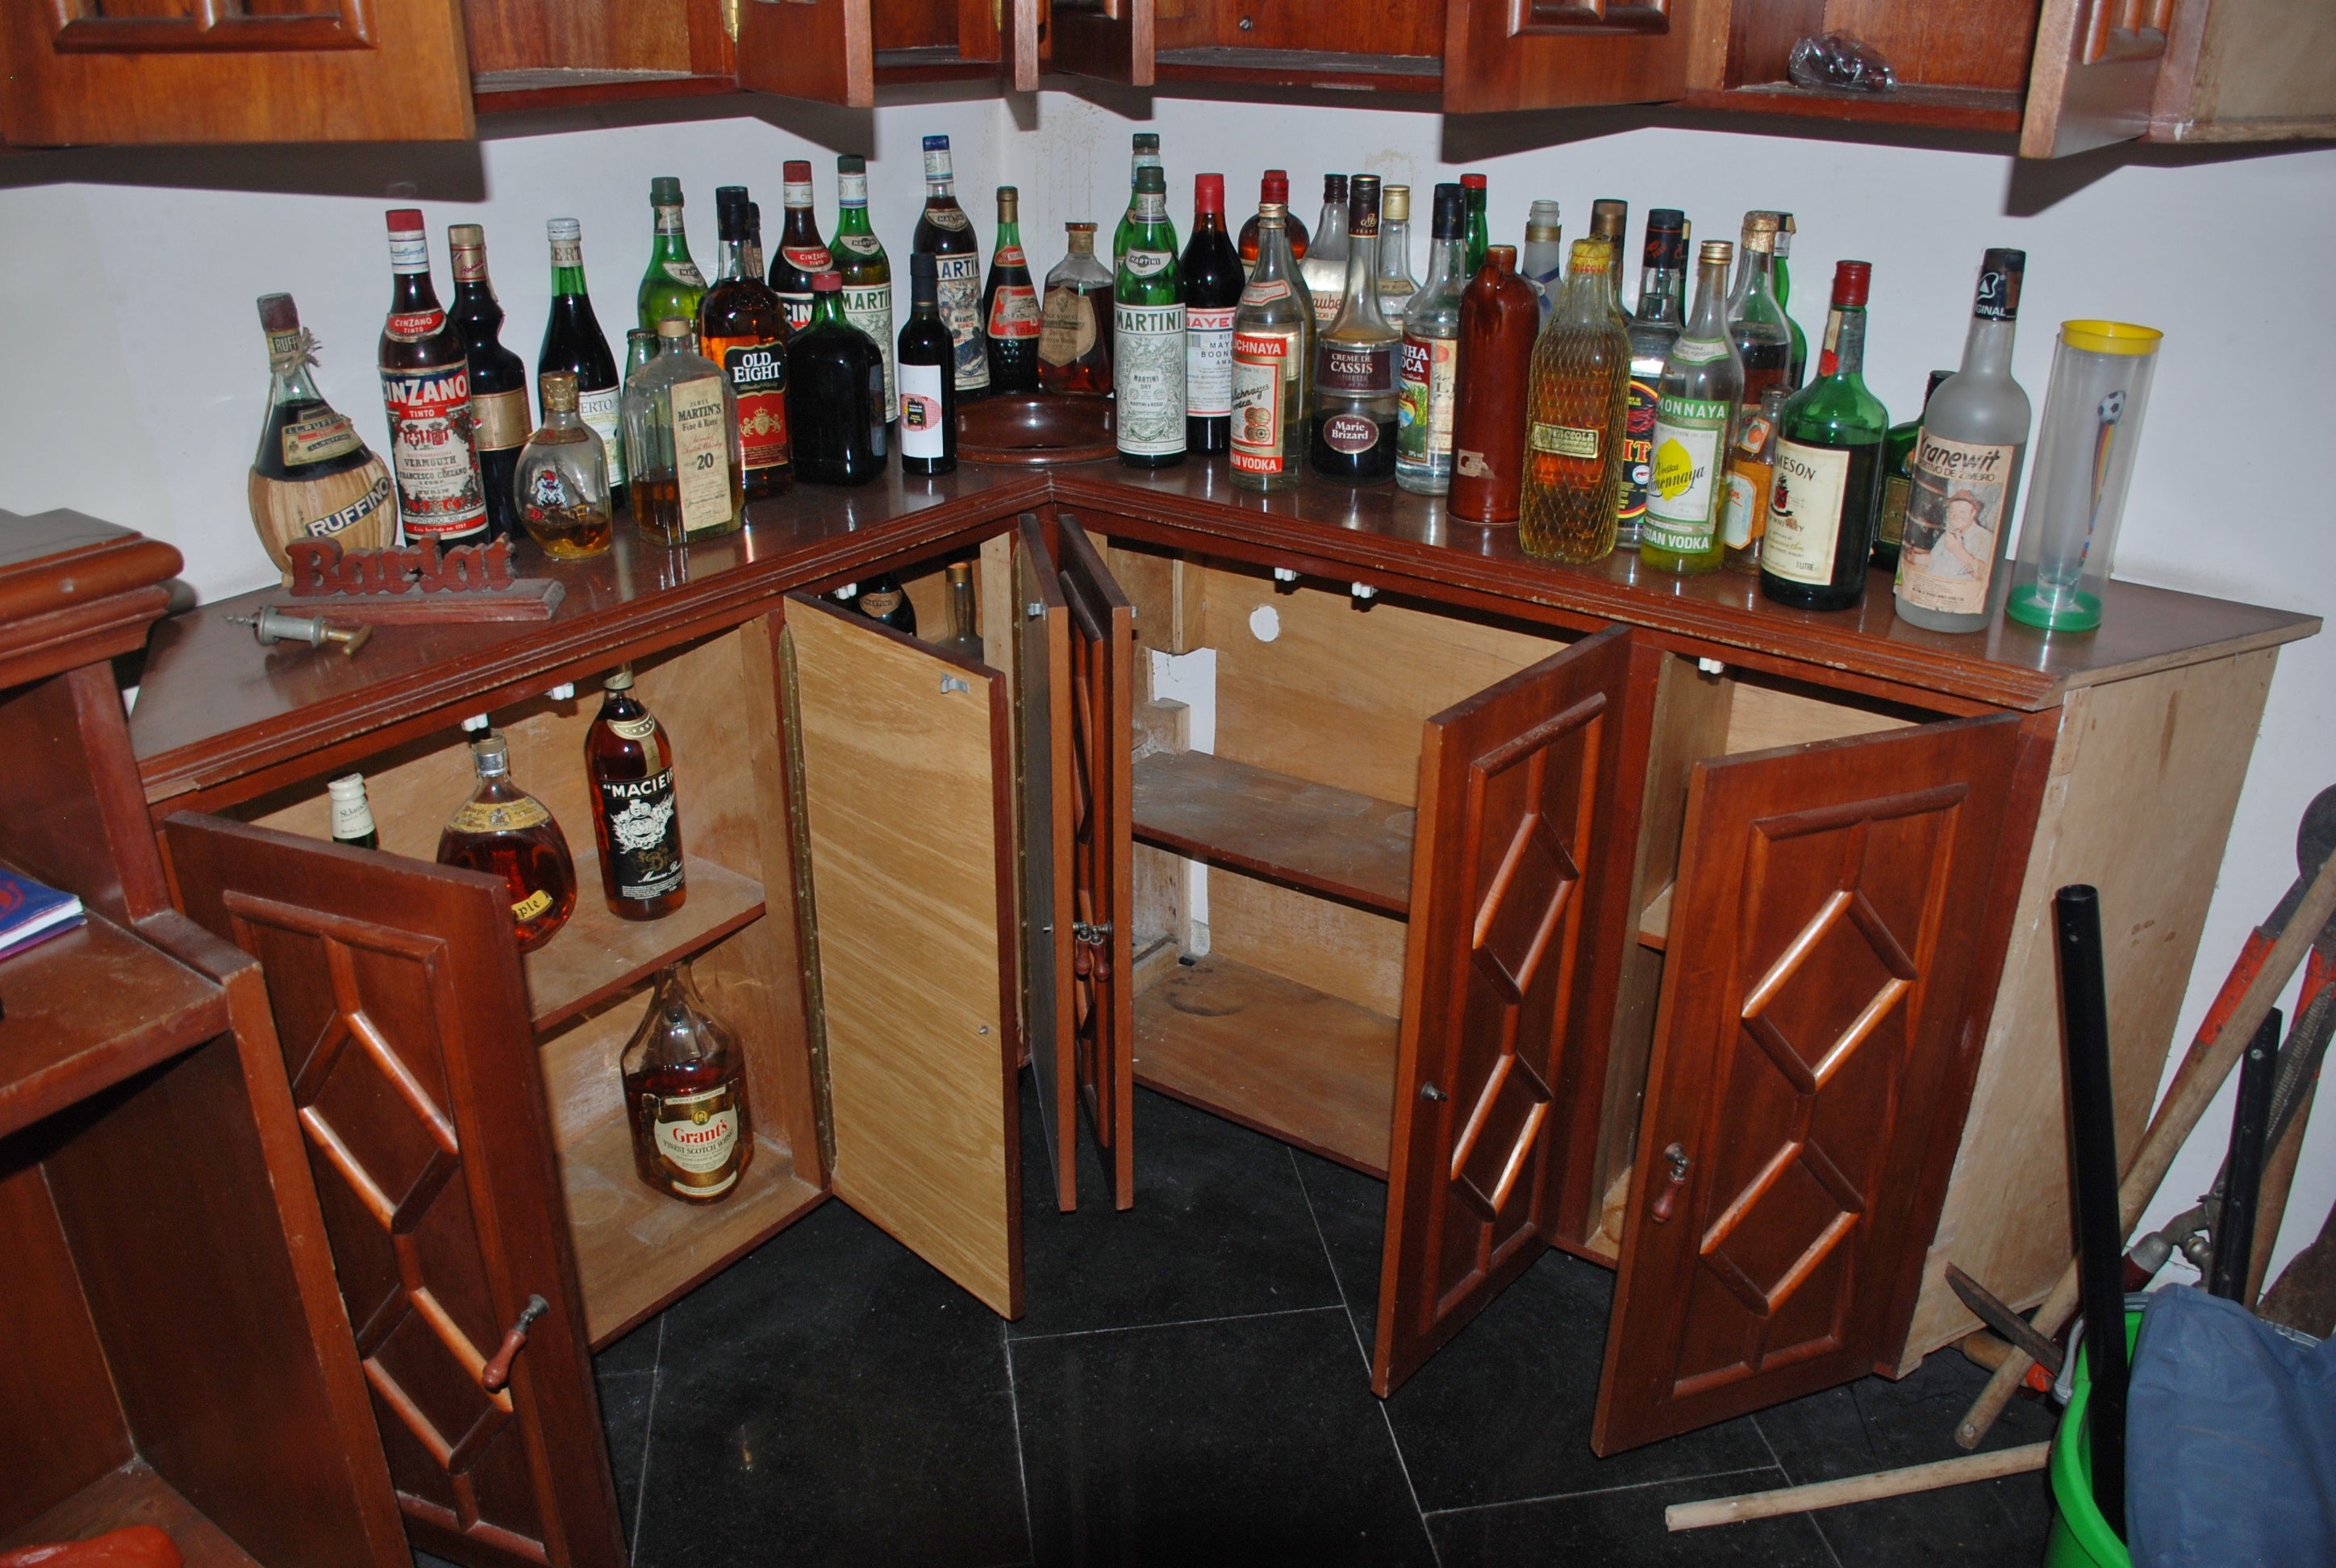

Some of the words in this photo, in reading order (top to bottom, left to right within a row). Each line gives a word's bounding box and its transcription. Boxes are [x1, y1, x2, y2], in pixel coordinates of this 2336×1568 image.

[1129, 255, 1161, 265] MARTINI
[937, 259, 979, 279] ARTIN
[394, 317, 432, 327] CINZANO
[1116, 310, 1182, 332] MARTINI
[742, 352, 772, 368] OLD
[1332, 353, 1360, 362] CREME
[1361, 354, 1372, 363] DE
[732, 361, 782, 383] EIGHT
[1331, 361, 1373, 374] CASSIS
[1133, 375, 1159, 383] MARTINI
[382, 374, 468, 407] CINZANO
[678, 403, 722, 422] MARTIN'S
[682, 422, 697, 432] Fine
[697, 420, 703, 428] &
[1335, 421, 1365, 431] Marie
[1332, 429, 1369, 440] Brizard
[404, 456, 457, 467] VERMOUTH
[697, 452, 715, 470] 20
[1242, 457, 1277, 470] VODKA
[1775, 452, 1817, 482] MESON
[1944, 468, 1957, 477] DE
[307, 477, 390, 538] RUFFINO
[1773, 518, 1805, 532] WHIKEY
[1669, 535, 1708, 549] VODKA
[516, 899, 541, 918] ple
[673, 1118, 728, 1144] Grant's
[686, 1144, 716, 1154] SCOTCH
